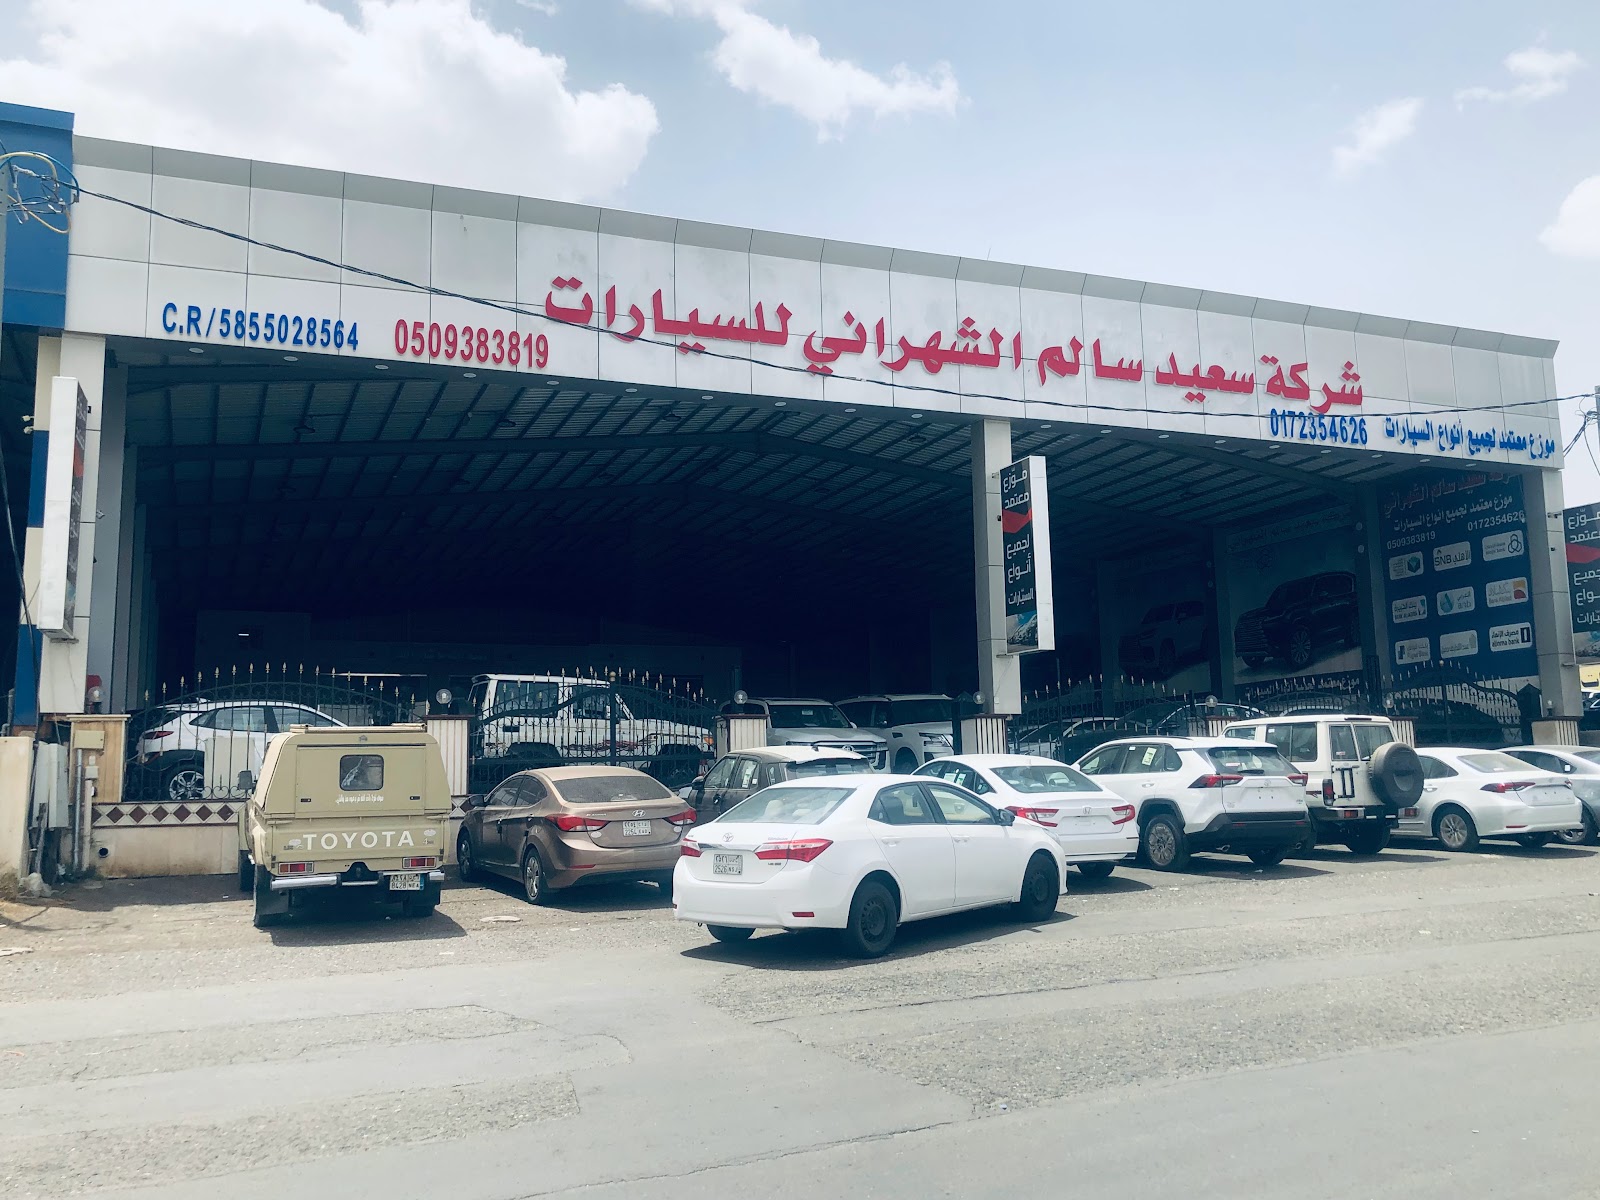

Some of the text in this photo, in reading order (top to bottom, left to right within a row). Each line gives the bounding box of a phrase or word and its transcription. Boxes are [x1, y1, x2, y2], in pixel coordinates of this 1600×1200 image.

[394, 318, 550, 369] 0509383819
[545, 275, 1363, 414] شركة سعيد سالم الشهراني للسيارات
[1270, 408, 1368, 445] 0172354626
[1385, 416, 1555, 460] موزع معتمد لجميع أنواع السيارات
[1004, 491, 1030, 510] معتمد
[1469, 498, 1493, 513] معتمد
[1467, 509, 1525, 531] 0172354626
[1006, 533, 1030, 560] لجميع
[1386, 531, 1436, 550] 0509383819
[1569, 530, 1600, 544] عتمد
[1434, 554, 1452, 566] SNB
[302, 830, 415, 851] TOYOTA
